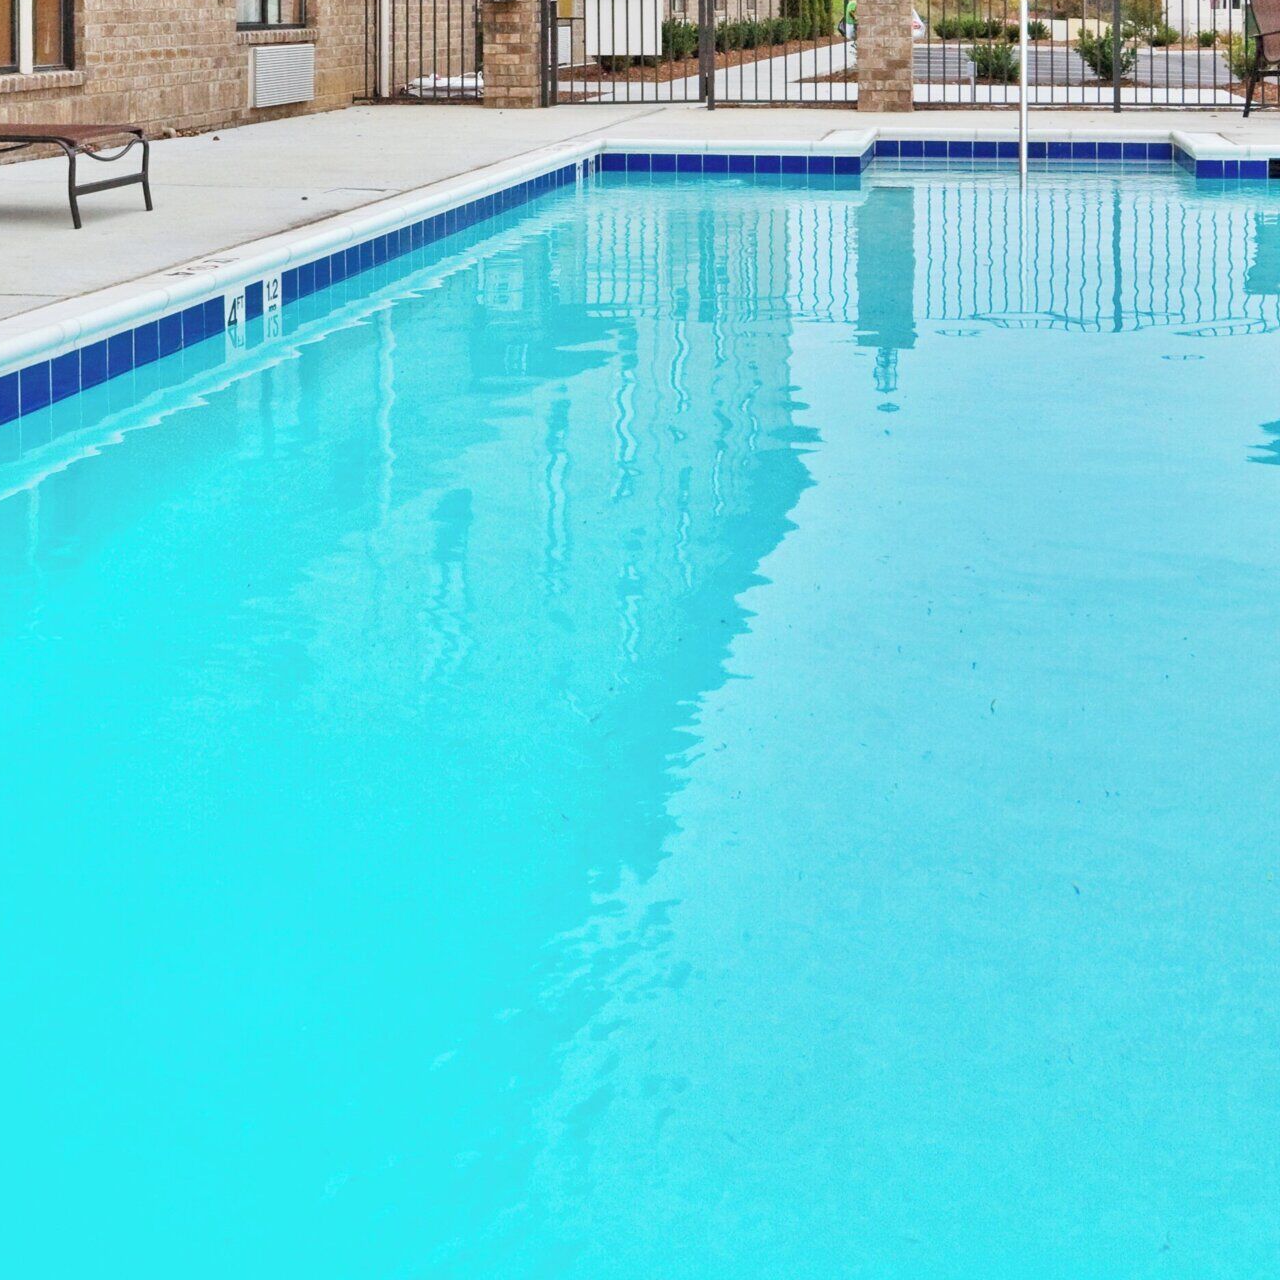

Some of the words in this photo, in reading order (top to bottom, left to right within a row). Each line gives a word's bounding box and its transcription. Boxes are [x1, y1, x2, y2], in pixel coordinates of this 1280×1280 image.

[267, 279, 278, 301] 1.2
[228, 298, 238, 326] 4
[236, 295, 244, 310] FT
